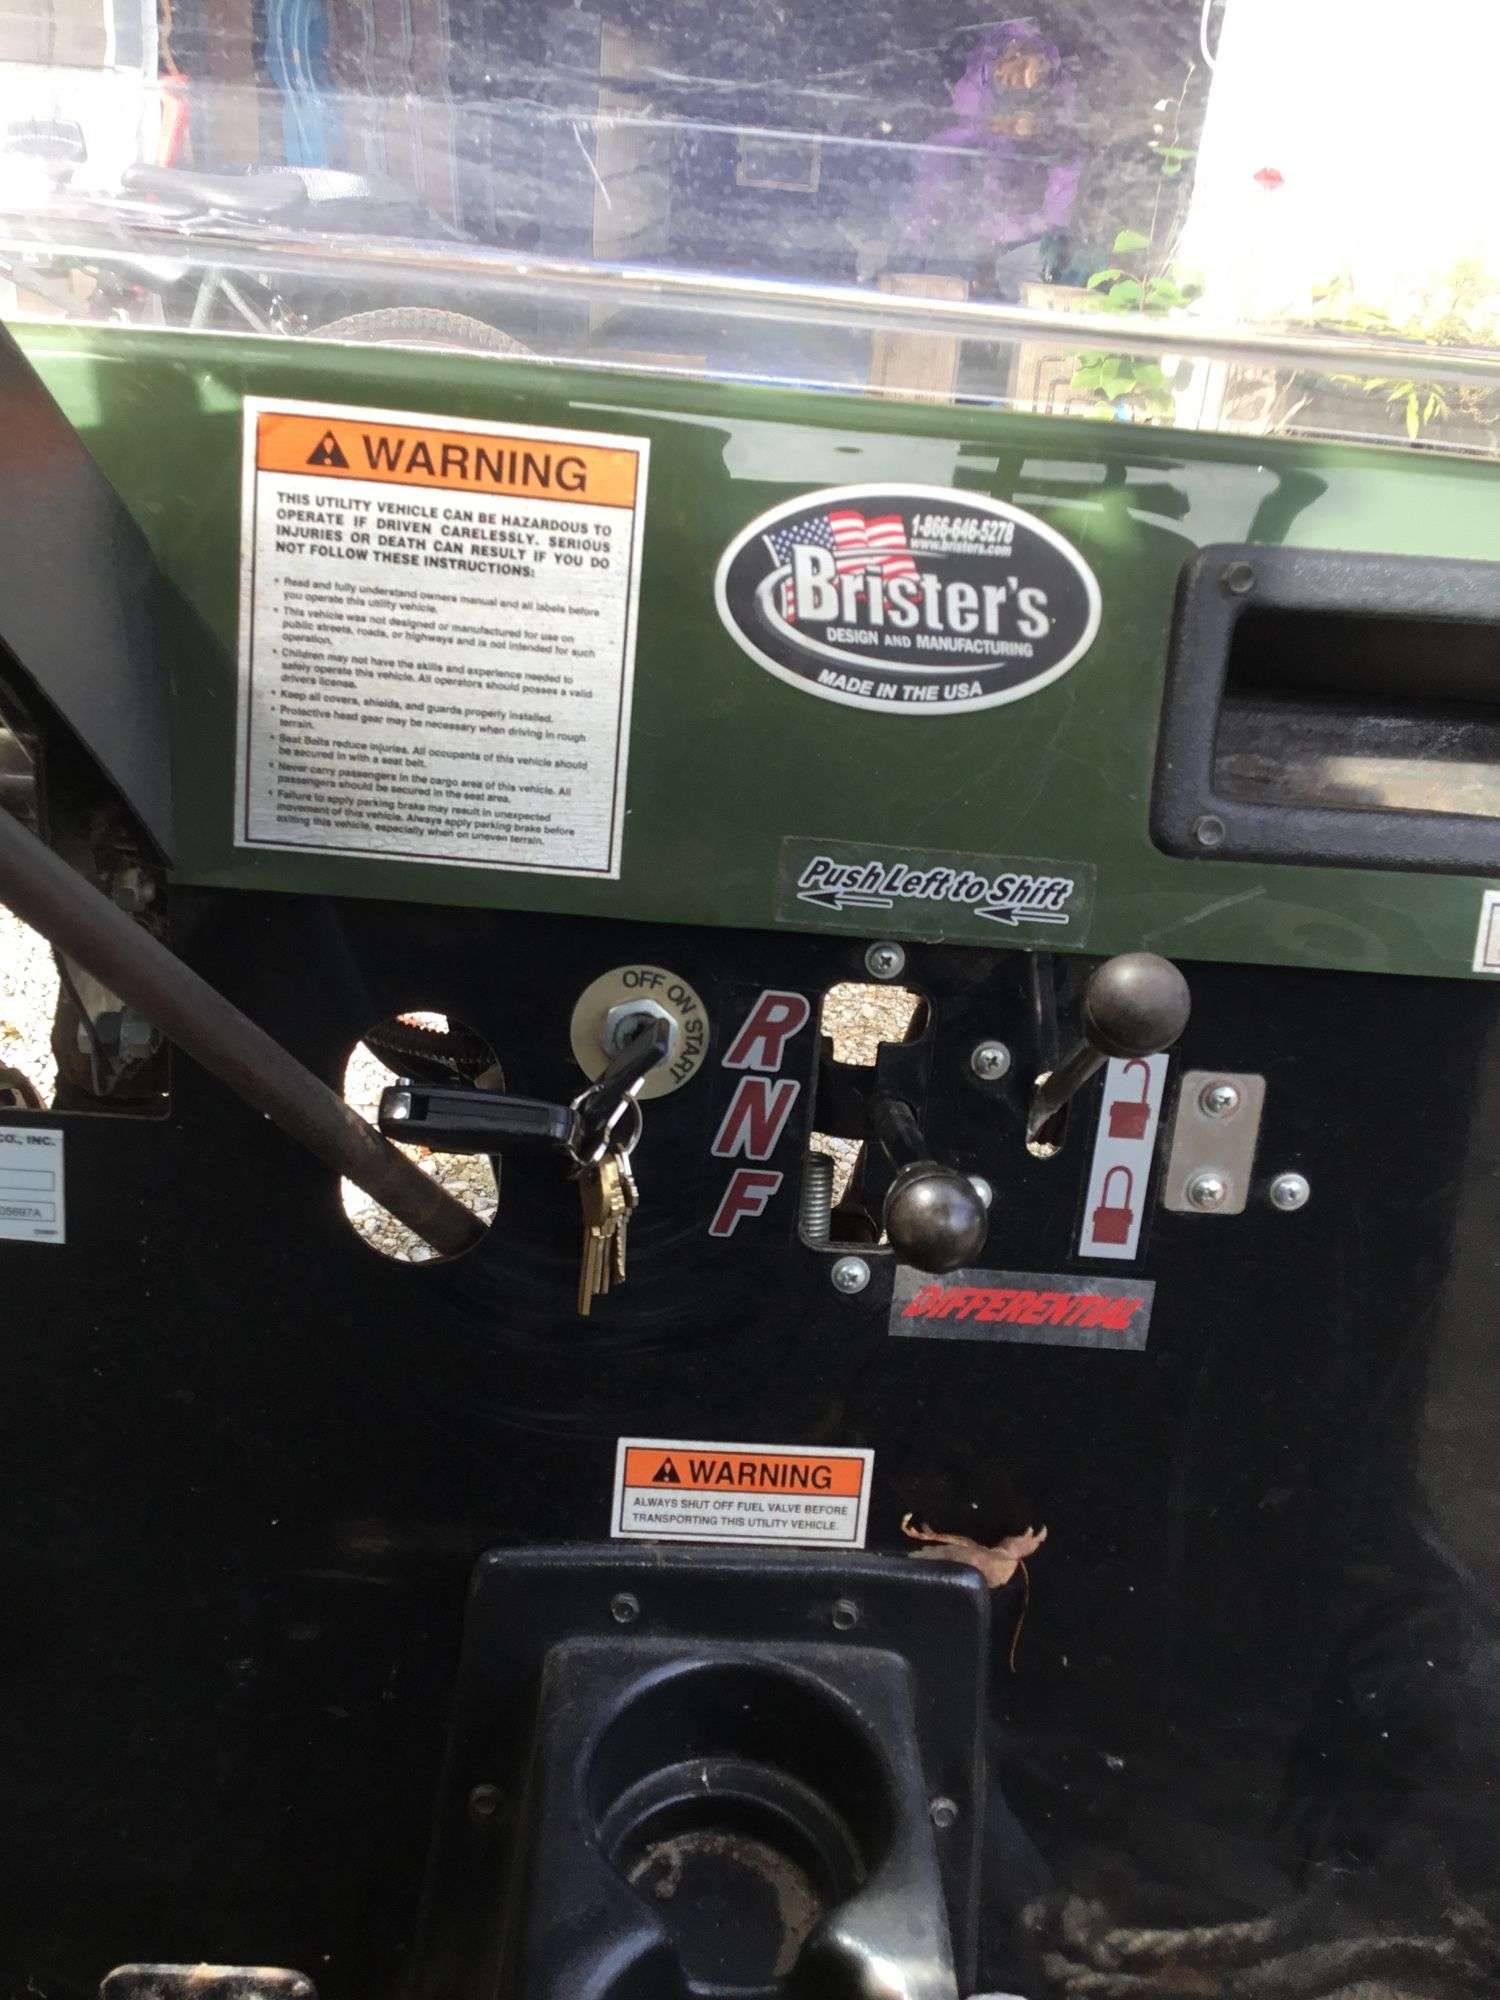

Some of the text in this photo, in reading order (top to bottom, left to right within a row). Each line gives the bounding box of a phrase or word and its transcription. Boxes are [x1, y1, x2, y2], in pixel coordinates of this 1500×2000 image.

[362, 434, 587, 492] WARNING
[276, 507, 611, 552] OPERATE IF DRIVEN CARELESSLY. SERIOUS
[277, 491, 612, 536] THIS UTILITY VEHICLE CAN BE HAZARDOUS TO
[275, 524, 610, 568] INJURIES OR DEATH CAN RESULT IF YOU DO
[275, 540, 304, 555] NOT
[309, 543, 368, 561] FOLLOW
[373, 550, 419, 566] THESE
[792, 543, 1049, 639] Brister's
[826, 627, 1034, 658] DESIGN AND MANUFACTURING
[817, 669, 983, 701] MADE IN THE USA
[799, 856, 1073, 909] Push Left to Shift
[622, 970, 704, 1084] OFF ON START
[722, 989, 810, 1072] R
[26, 1135, 56, 1146] INC.
[711, 1075, 801, 1161] N
[709, 1168, 783, 1237] F
[901, 1284, 1144, 1333] DIFFERENTIAL
[689, 1460, 832, 1489] WARNING
[632, 1513, 839, 1531] TRANSPORTING THIS UTILITY VEHICLE.
[633, 1497, 848, 1516] ALWAYS SHUT OFF FUEL VALVE BEFORE
